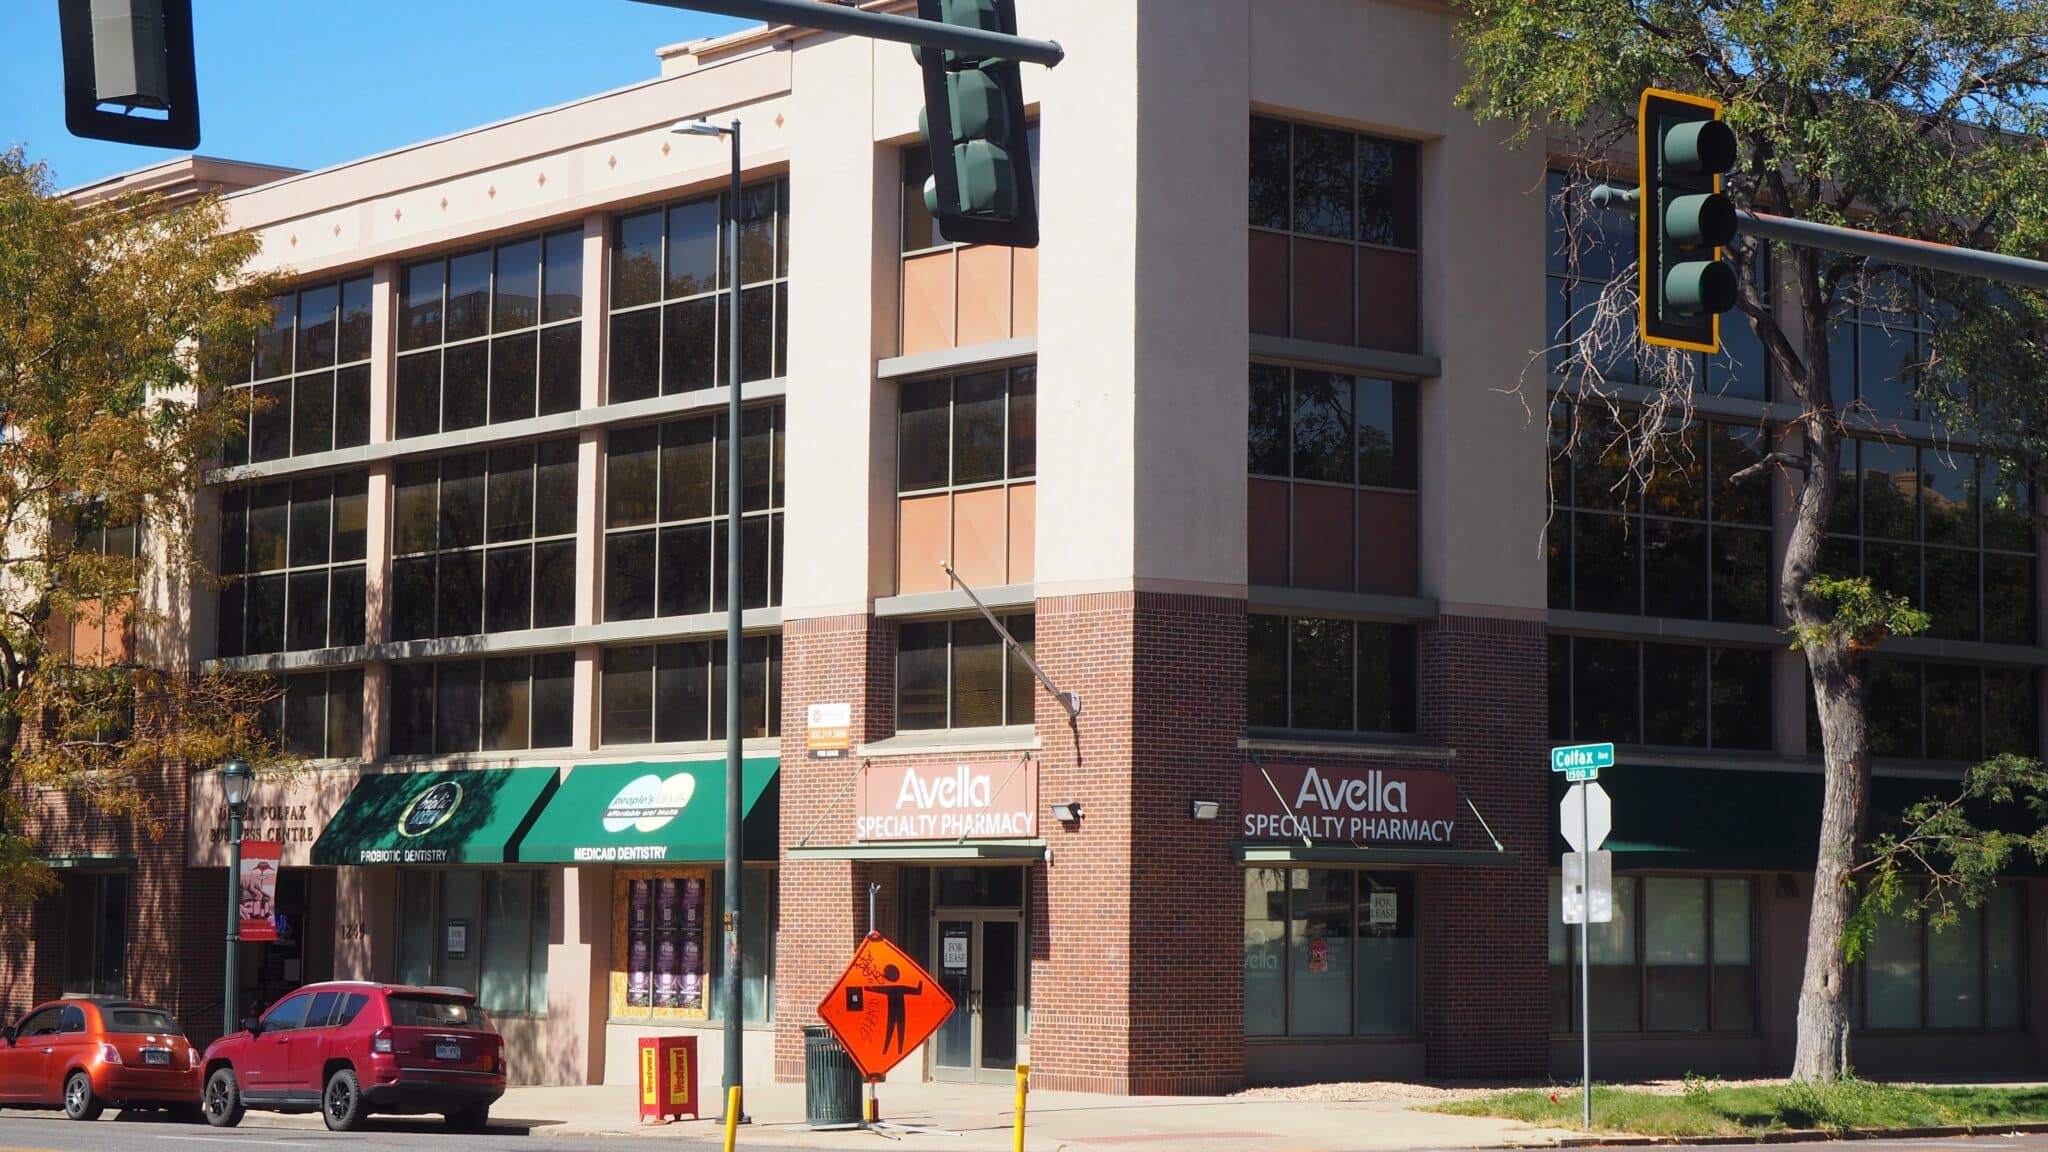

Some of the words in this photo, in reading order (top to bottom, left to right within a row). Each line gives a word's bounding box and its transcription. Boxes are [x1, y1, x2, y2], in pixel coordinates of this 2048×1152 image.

[1556, 750, 1593, 767] Colfax
[896, 766, 992, 809] Avella
[1295, 767, 1408, 813] Avella
[260, 806, 307, 821] COLFAX
[857, 815, 937, 838] SPECIALTY
[941, 811, 1034, 836] PHARMACY
[1244, 814, 1345, 838] SPECIALTY
[1351, 817, 1454, 841] PHARMACY
[210, 827, 262, 842] BUSESS
[267, 827, 313, 842] CENTRE
[360, 850, 401, 862] PROBIOTIC
[404, 849, 447, 861] DENTISTRY
[574, 847, 616, 860] MEDICAID
[617, 846, 667, 860] DENTISTRY
[1375, 897, 1392, 907] FOR
[1371, 909, 1396, 919] LEASE
[948, 942, 963, 952] FOR
[944, 953, 966, 962] LEASE
[673, 1049, 684, 1095] Westword
